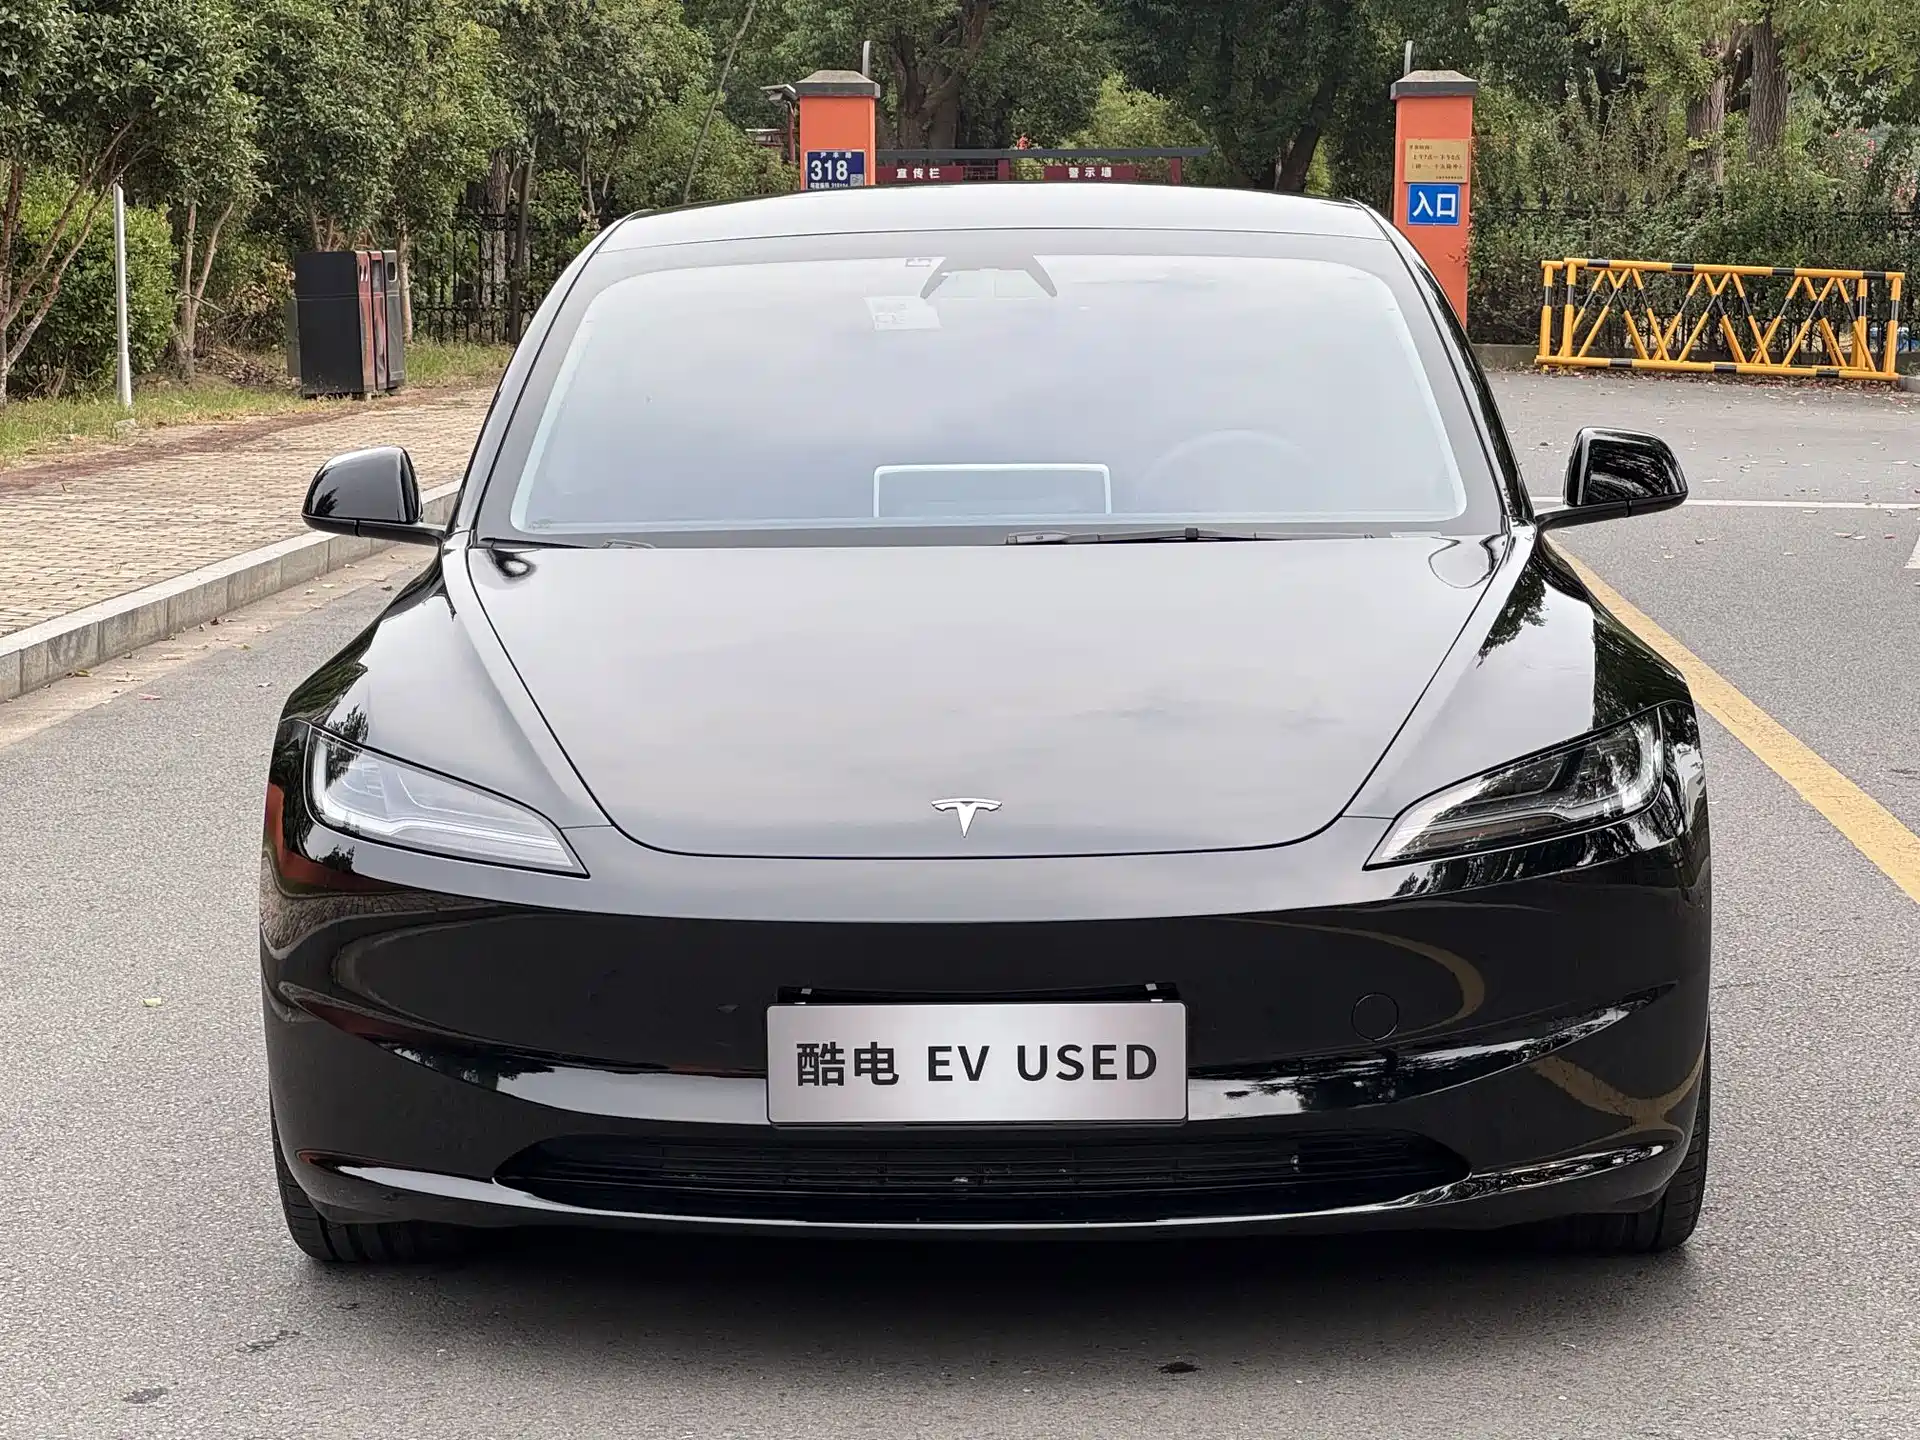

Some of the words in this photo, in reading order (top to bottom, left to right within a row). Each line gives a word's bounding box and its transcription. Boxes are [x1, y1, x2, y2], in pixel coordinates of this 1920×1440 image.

[811, 160, 848, 180] 318
[896, 168, 940, 179] 宣传栏
[1068, 167, 1111, 178] 警示墙
[1412, 191, 1456, 217] 入口
[796, 1041, 899, 1087] 酷电
[928, 1045, 990, 1082] EV
[1017, 1044, 1157, 1082] USED
